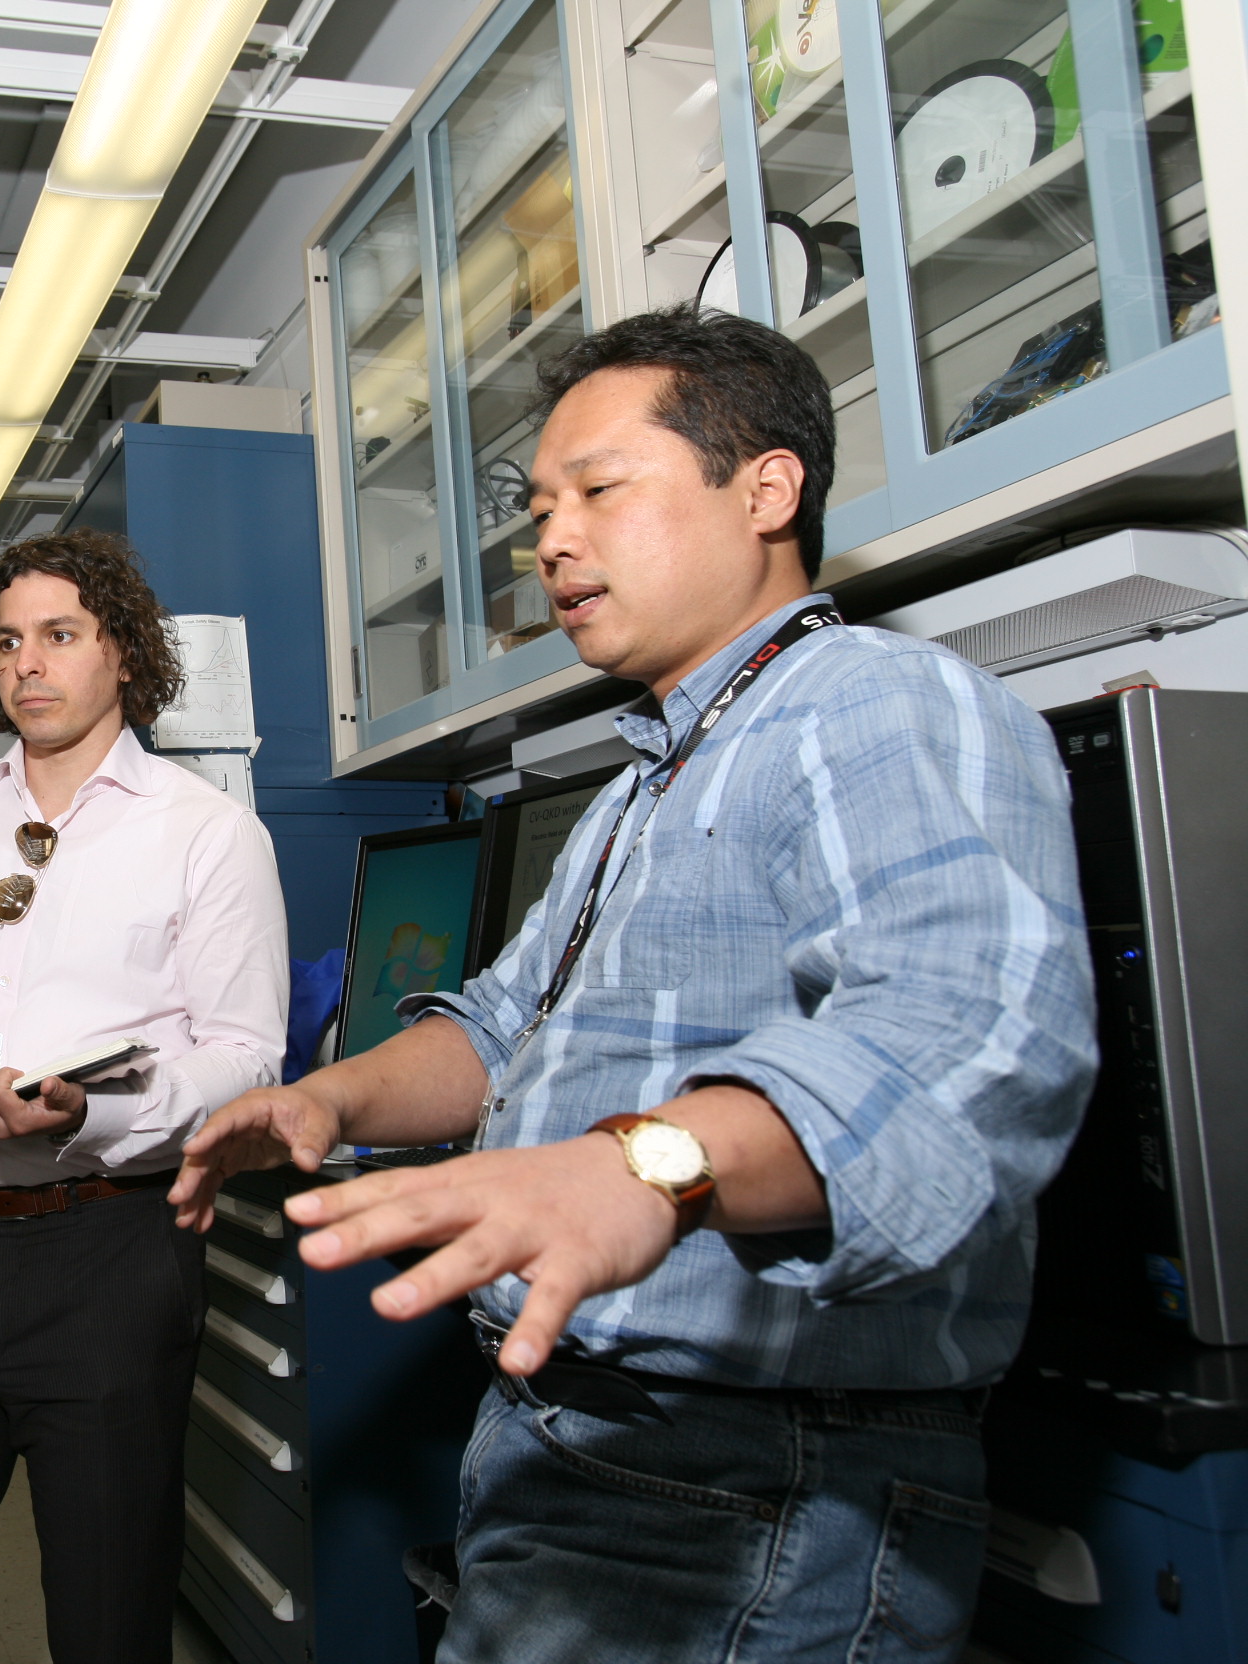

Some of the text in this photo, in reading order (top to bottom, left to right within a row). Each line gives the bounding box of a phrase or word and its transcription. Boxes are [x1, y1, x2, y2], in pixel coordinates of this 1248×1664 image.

[701, 643, 782, 730] DILAS
[529, 806, 560, 824] CV-QKD
[562, 801, 580, 816] with
